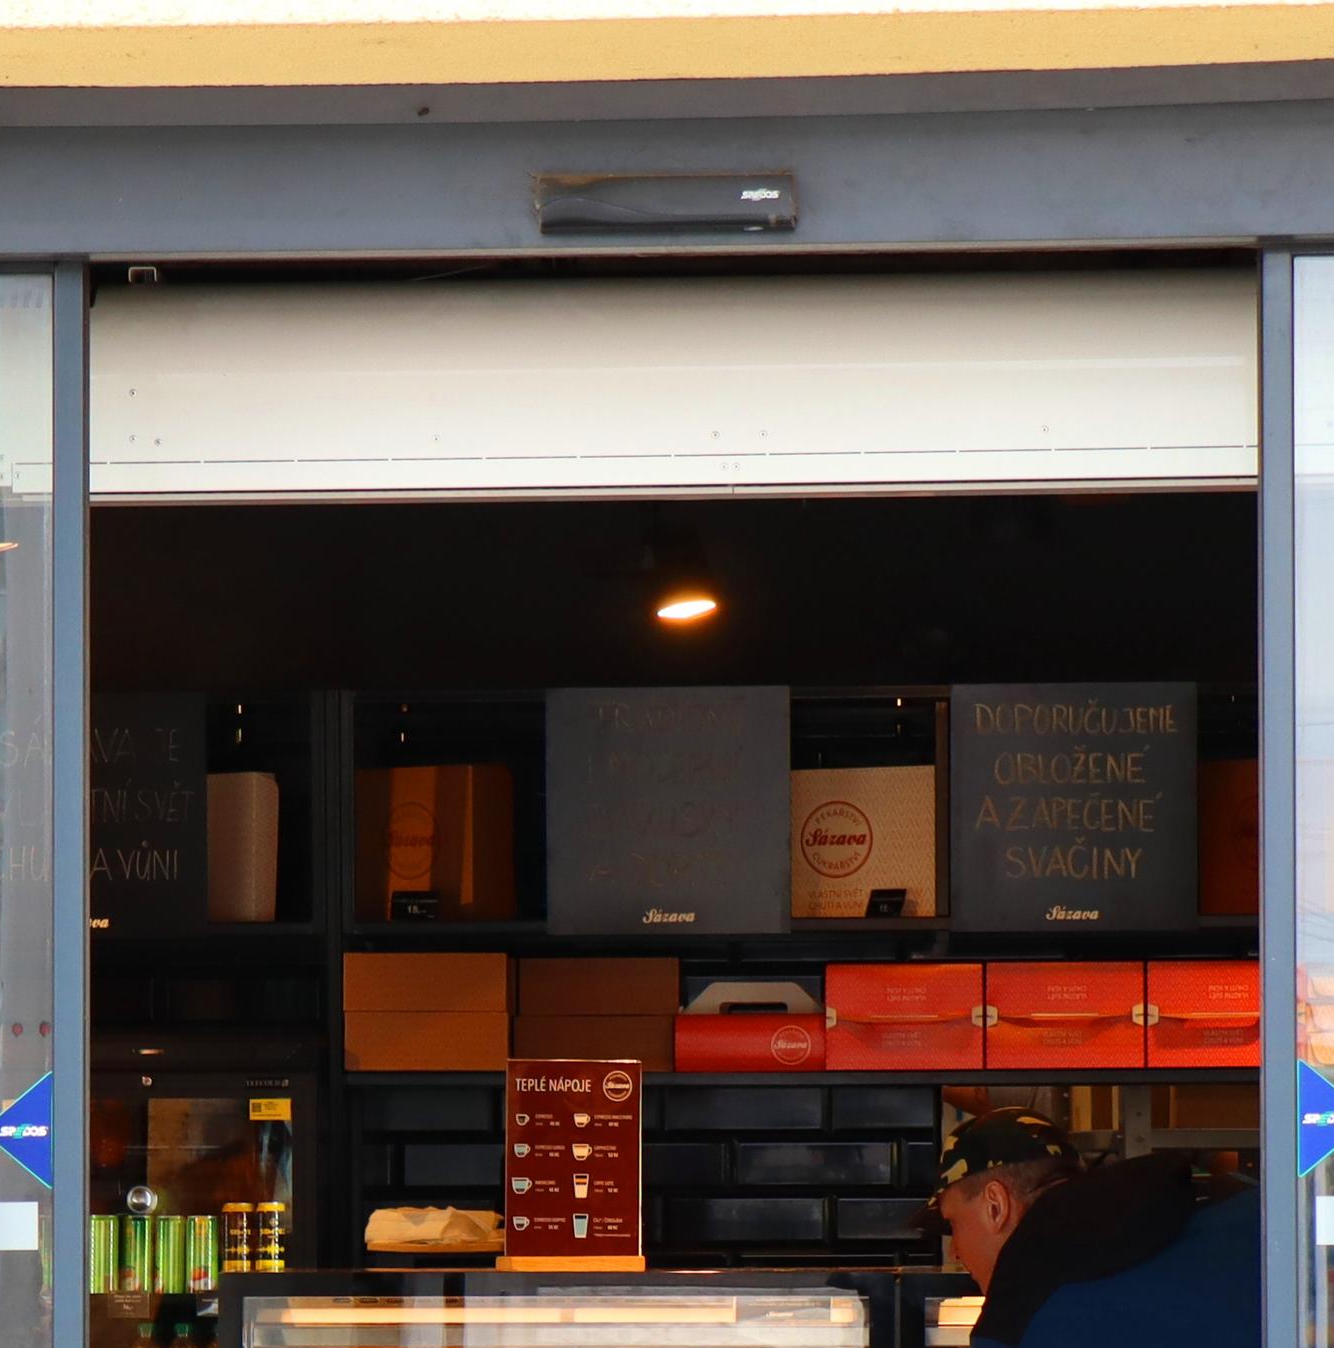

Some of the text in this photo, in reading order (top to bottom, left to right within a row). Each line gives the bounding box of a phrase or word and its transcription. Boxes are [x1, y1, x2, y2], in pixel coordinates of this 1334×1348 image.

[973, 698, 1179, 736] DOPORUČUJEME
[994, 744, 1150, 785] OBLOŽENÉ
[975, 795, 1000, 832] A
[805, 828, 867, 847] Sázava
[1005, 835, 1143, 880] SVAČINY
[642, 908, 696, 923] Sázava
[1045, 905, 1099, 921] Sázava
[515, 1076, 591, 1092] TEPLÉ NÁPOJE
